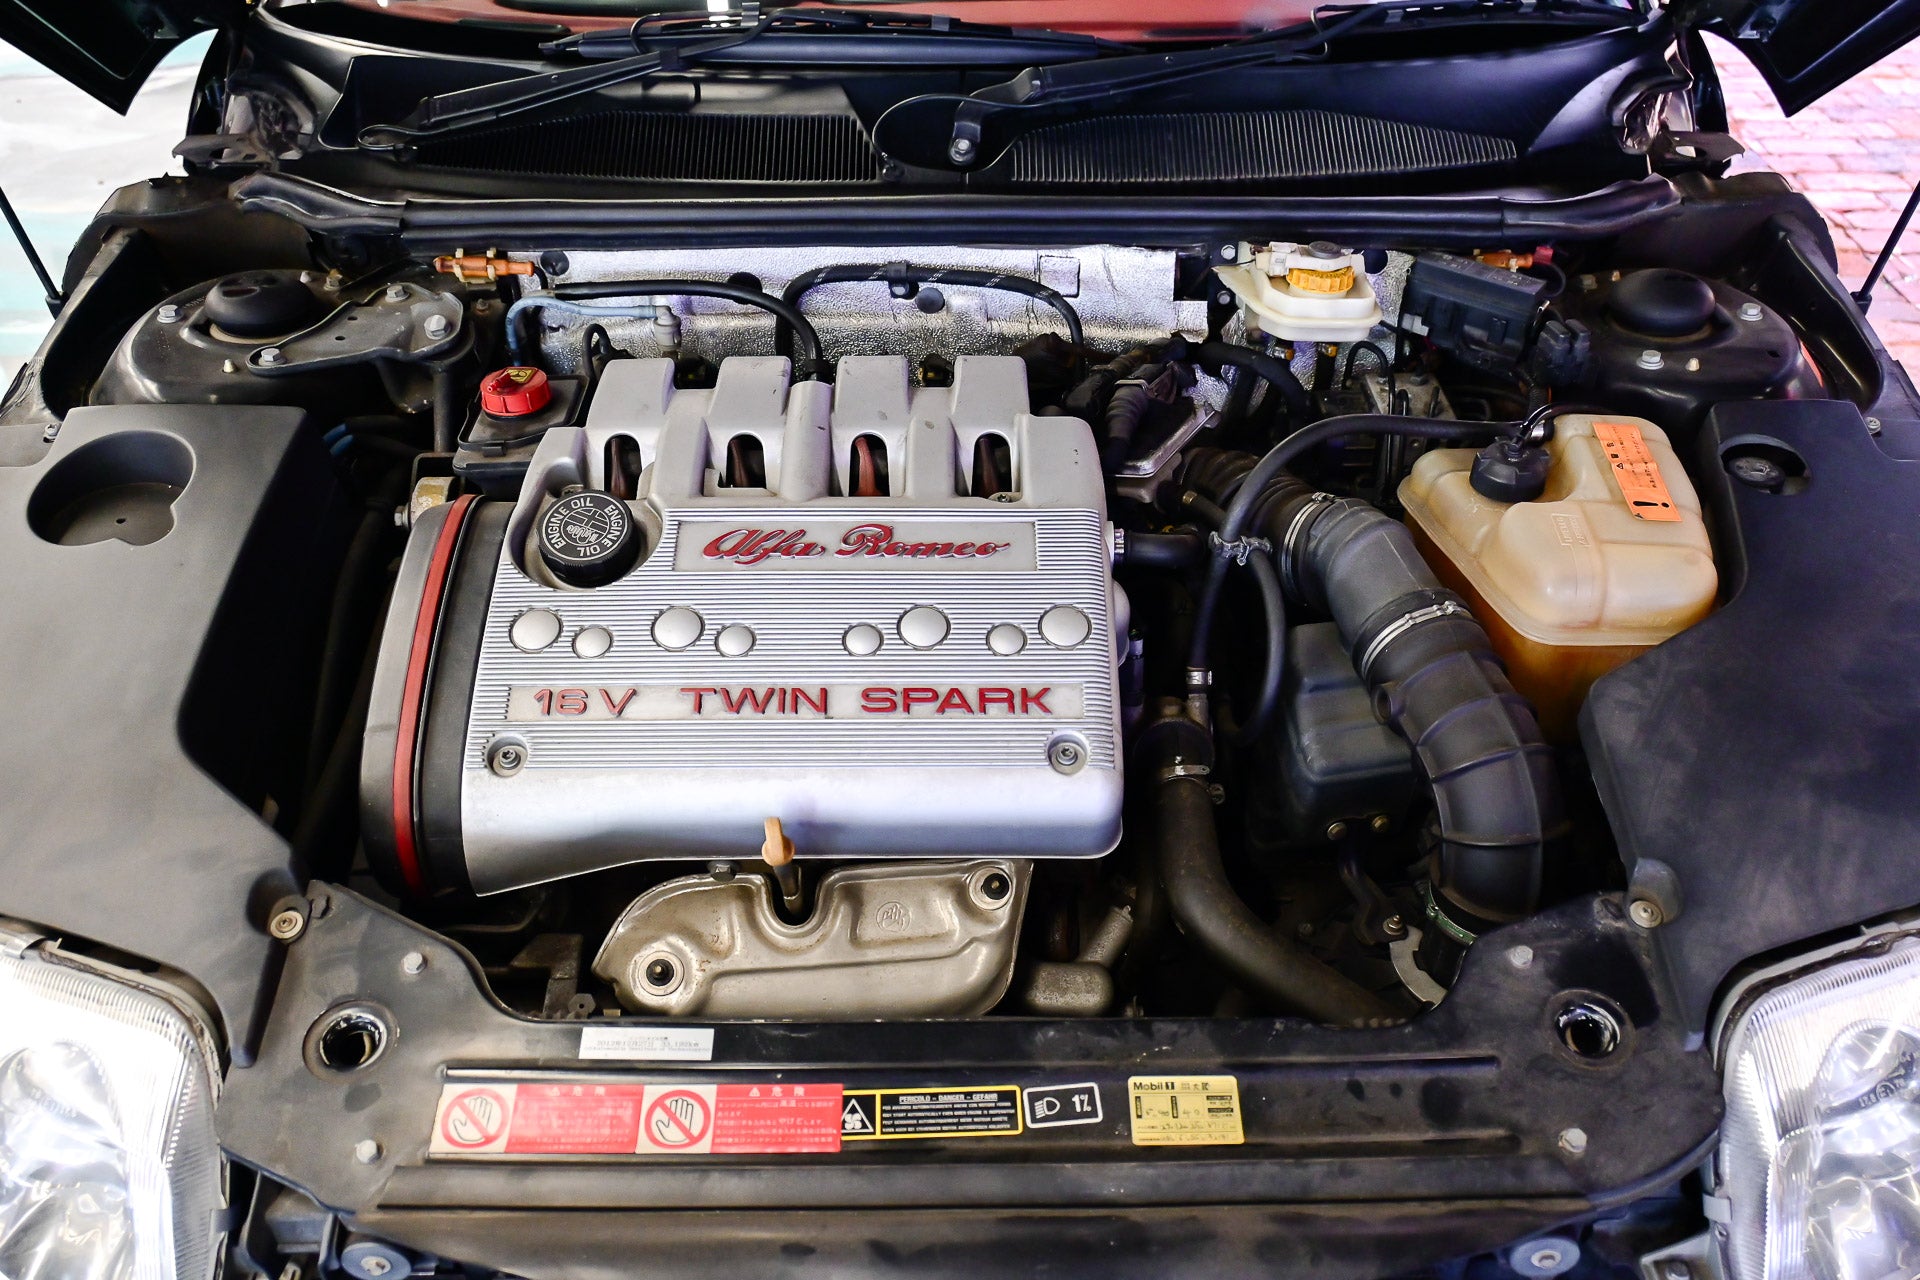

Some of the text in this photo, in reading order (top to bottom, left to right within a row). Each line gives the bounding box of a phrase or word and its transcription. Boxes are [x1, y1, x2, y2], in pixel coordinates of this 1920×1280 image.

[548, 497, 594, 549] ENGINE OIL
[577, 504, 623, 557] ENGINE OIL
[703, 524, 1008, 564] Alfa Romeo
[680, 688, 827, 713] TWIN
[861, 687, 1051, 713] SPARK
[1134, 1082, 1163, 1090] Mobil
[1072, 1094, 1091, 1112] 1%
